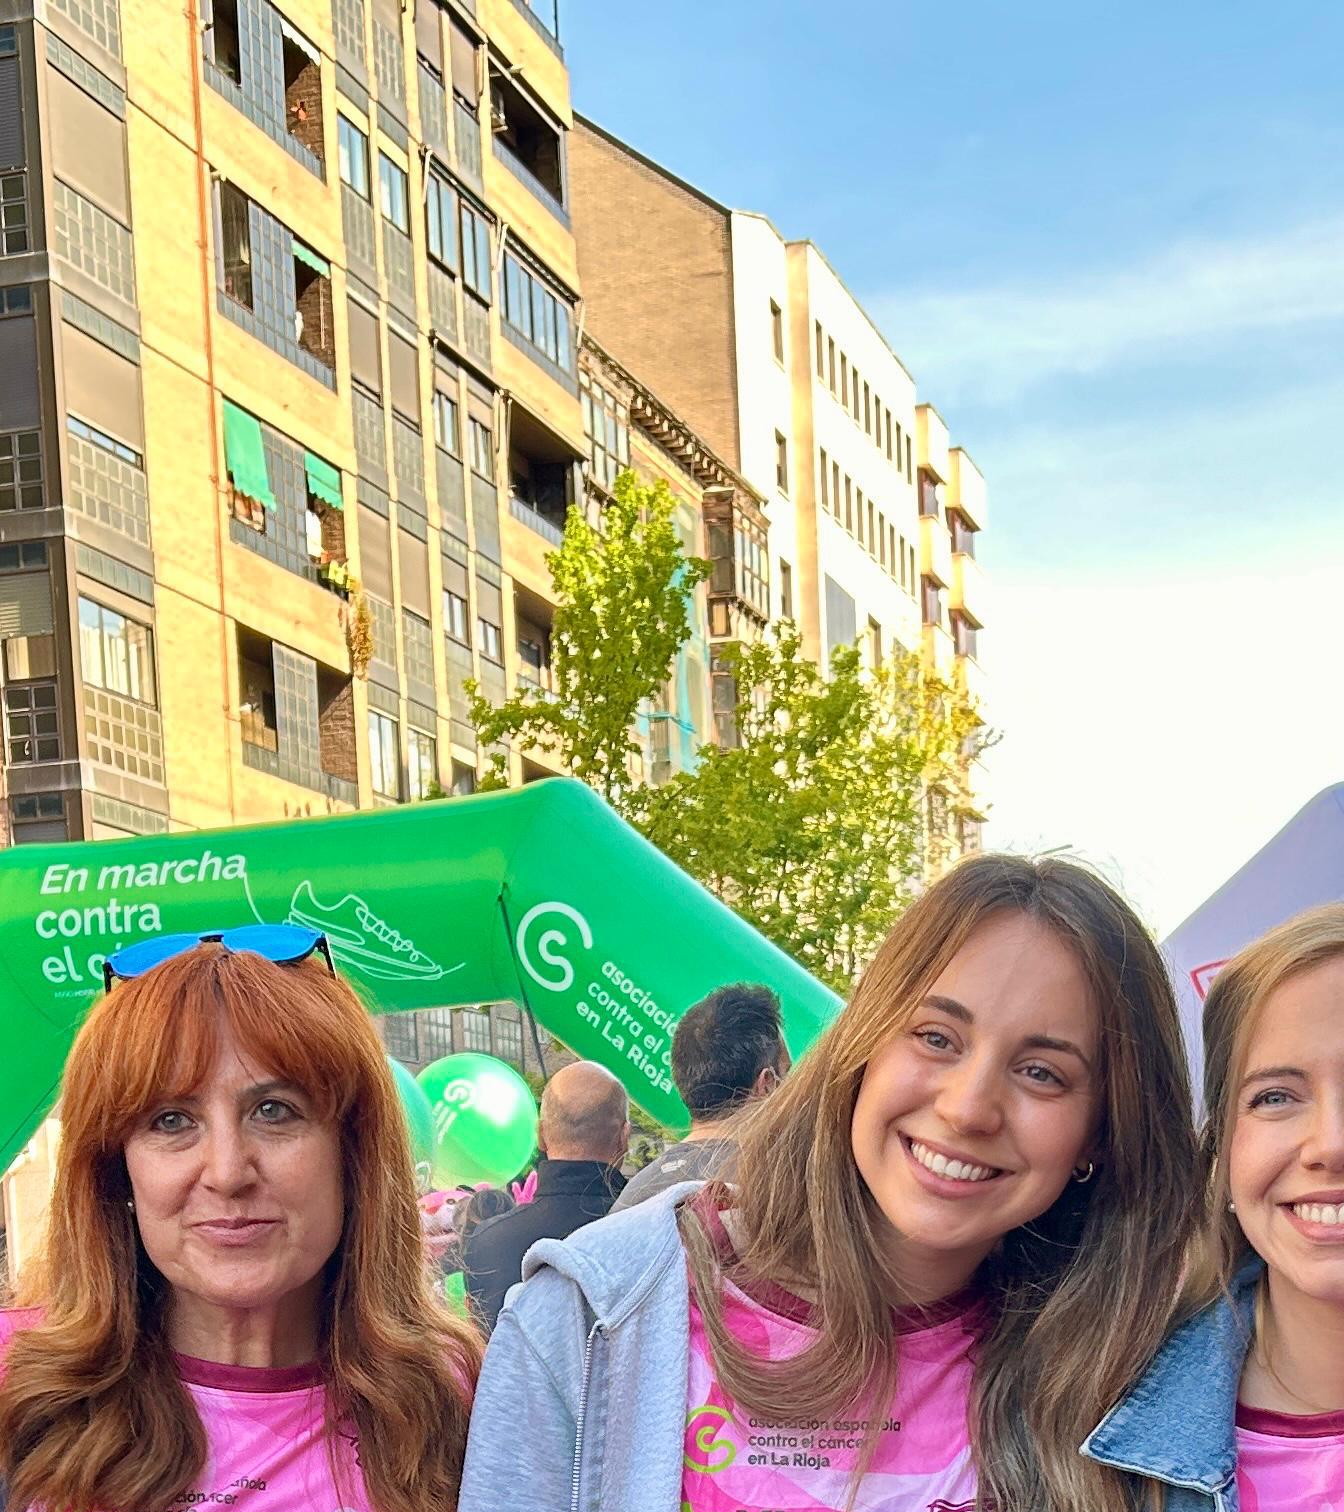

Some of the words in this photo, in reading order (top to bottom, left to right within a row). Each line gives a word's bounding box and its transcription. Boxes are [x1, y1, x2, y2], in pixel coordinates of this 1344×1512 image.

[40, 863, 88, 894] En
[97, 850, 246, 890] marcha
[35, 898, 162, 939] contra
[42, 946, 83, 983] el
[588, 982, 643, 1037] contra
[643, 1031, 665, 1054] el
[576, 1001, 600, 1028] en
[601, 1022, 625, 1051] La
[626, 1044, 673, 1095] Rioja
[748, 1434, 798, 1448] contra
[801, 1436, 814, 1449] el
[748, 1453, 767, 1465] en
[771, 1453, 789, 1466] La
[793, 1453, 830, 1470] Rioja
